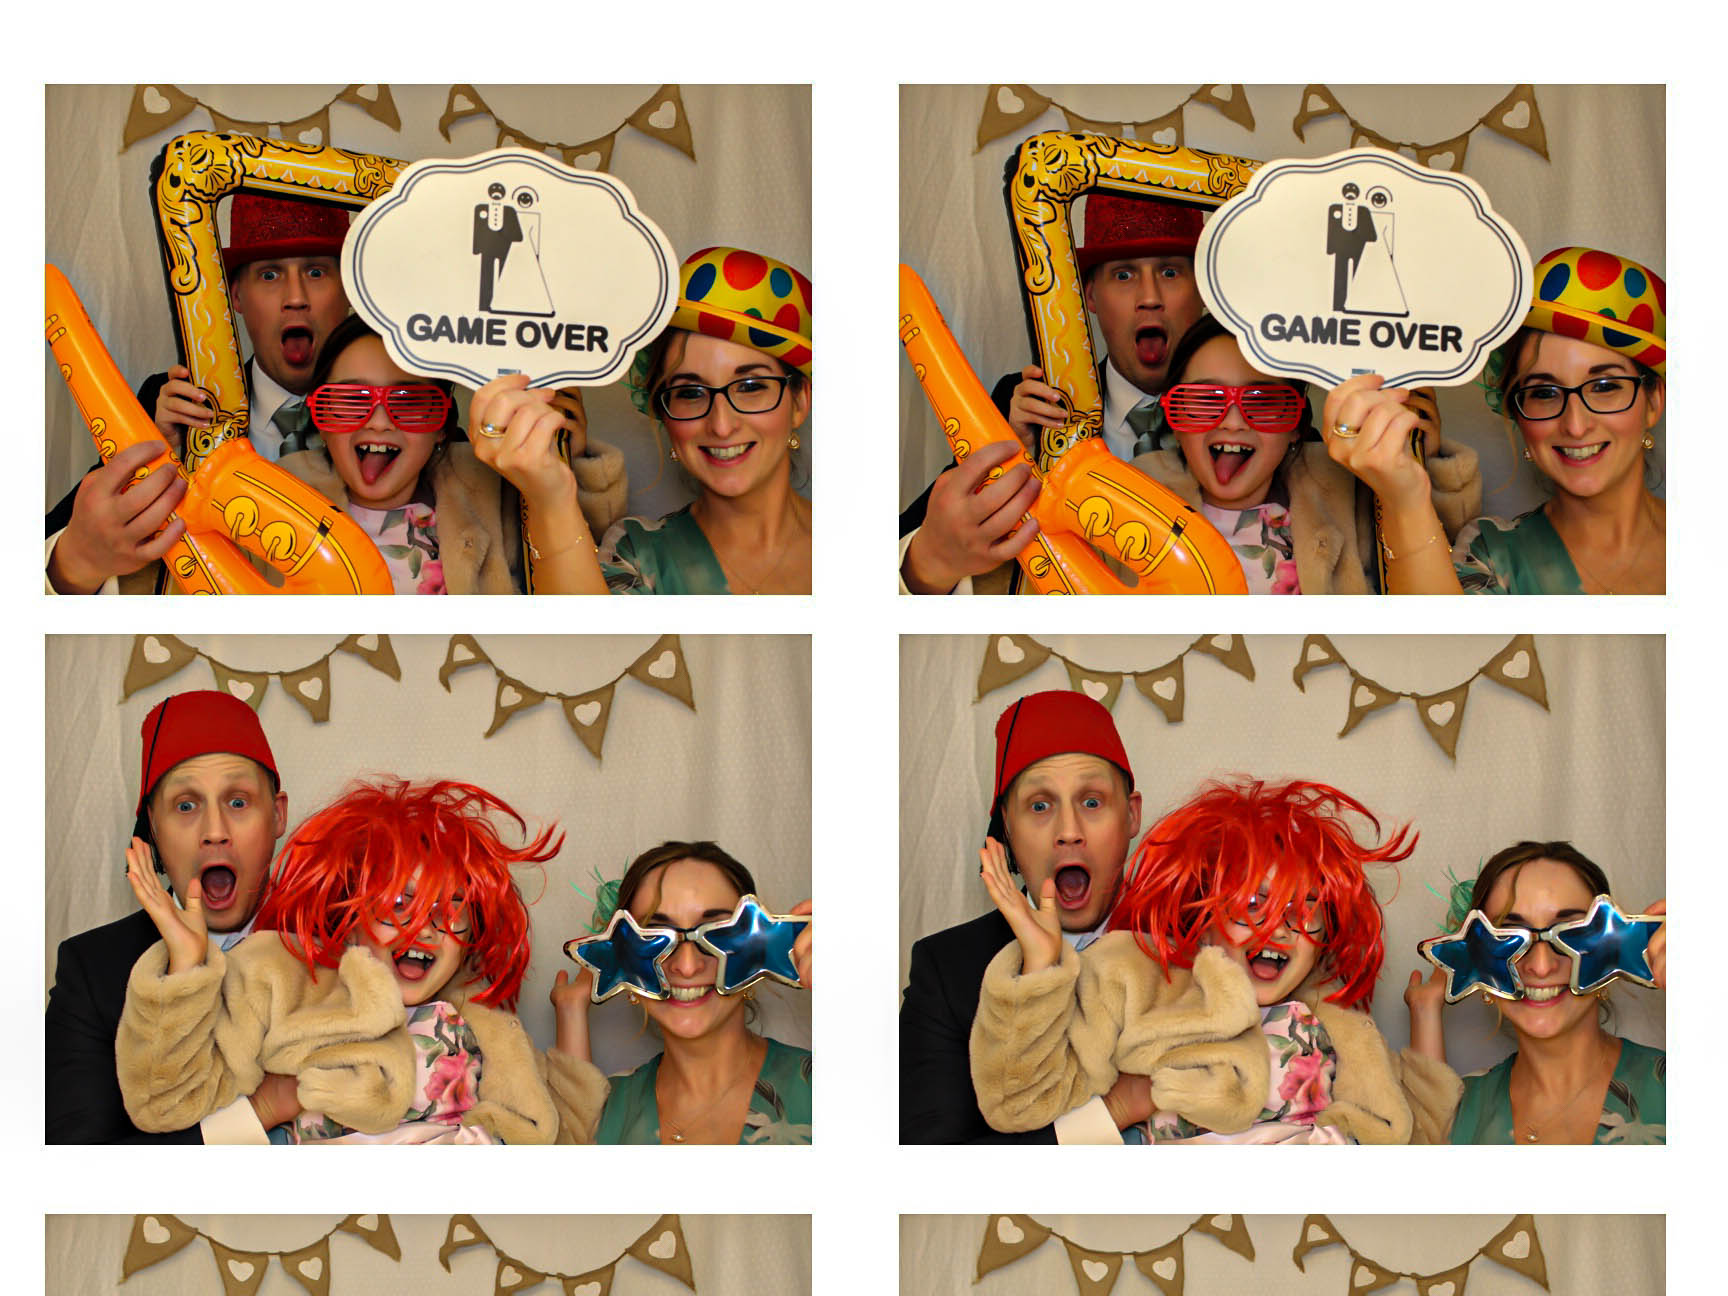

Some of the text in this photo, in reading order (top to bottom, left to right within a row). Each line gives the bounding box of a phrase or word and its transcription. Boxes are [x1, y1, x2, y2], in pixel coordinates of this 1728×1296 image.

[406, 313, 609, 353] GAME OVER
[1260, 313, 1463, 353] GAME OVER
